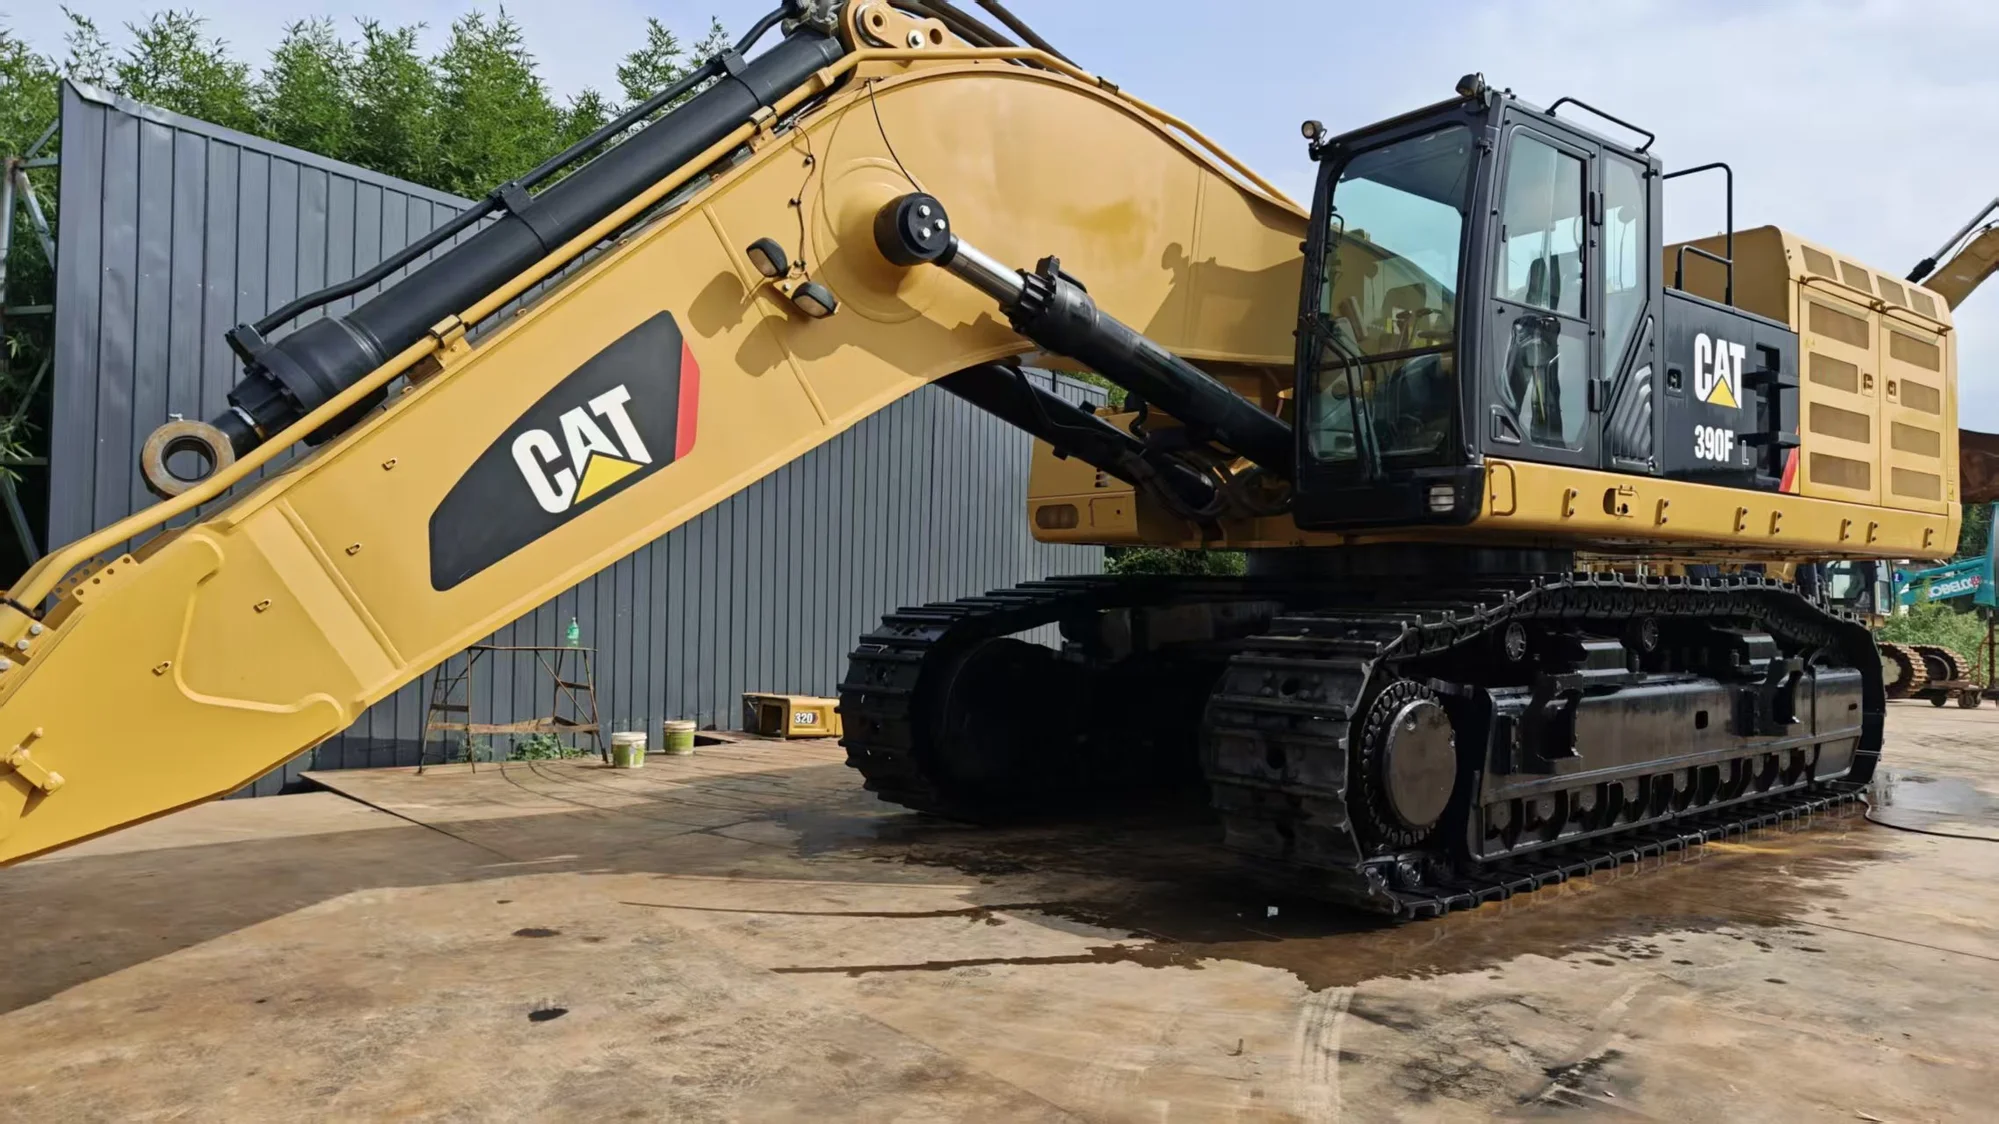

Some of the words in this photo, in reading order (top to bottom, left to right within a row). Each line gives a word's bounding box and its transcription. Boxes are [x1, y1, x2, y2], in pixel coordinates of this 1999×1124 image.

[1694, 333, 1745, 409] CAT
[511, 384, 652, 514] CAT
[1694, 424, 1734, 462] 390F
[795, 712, 814, 724] 320
